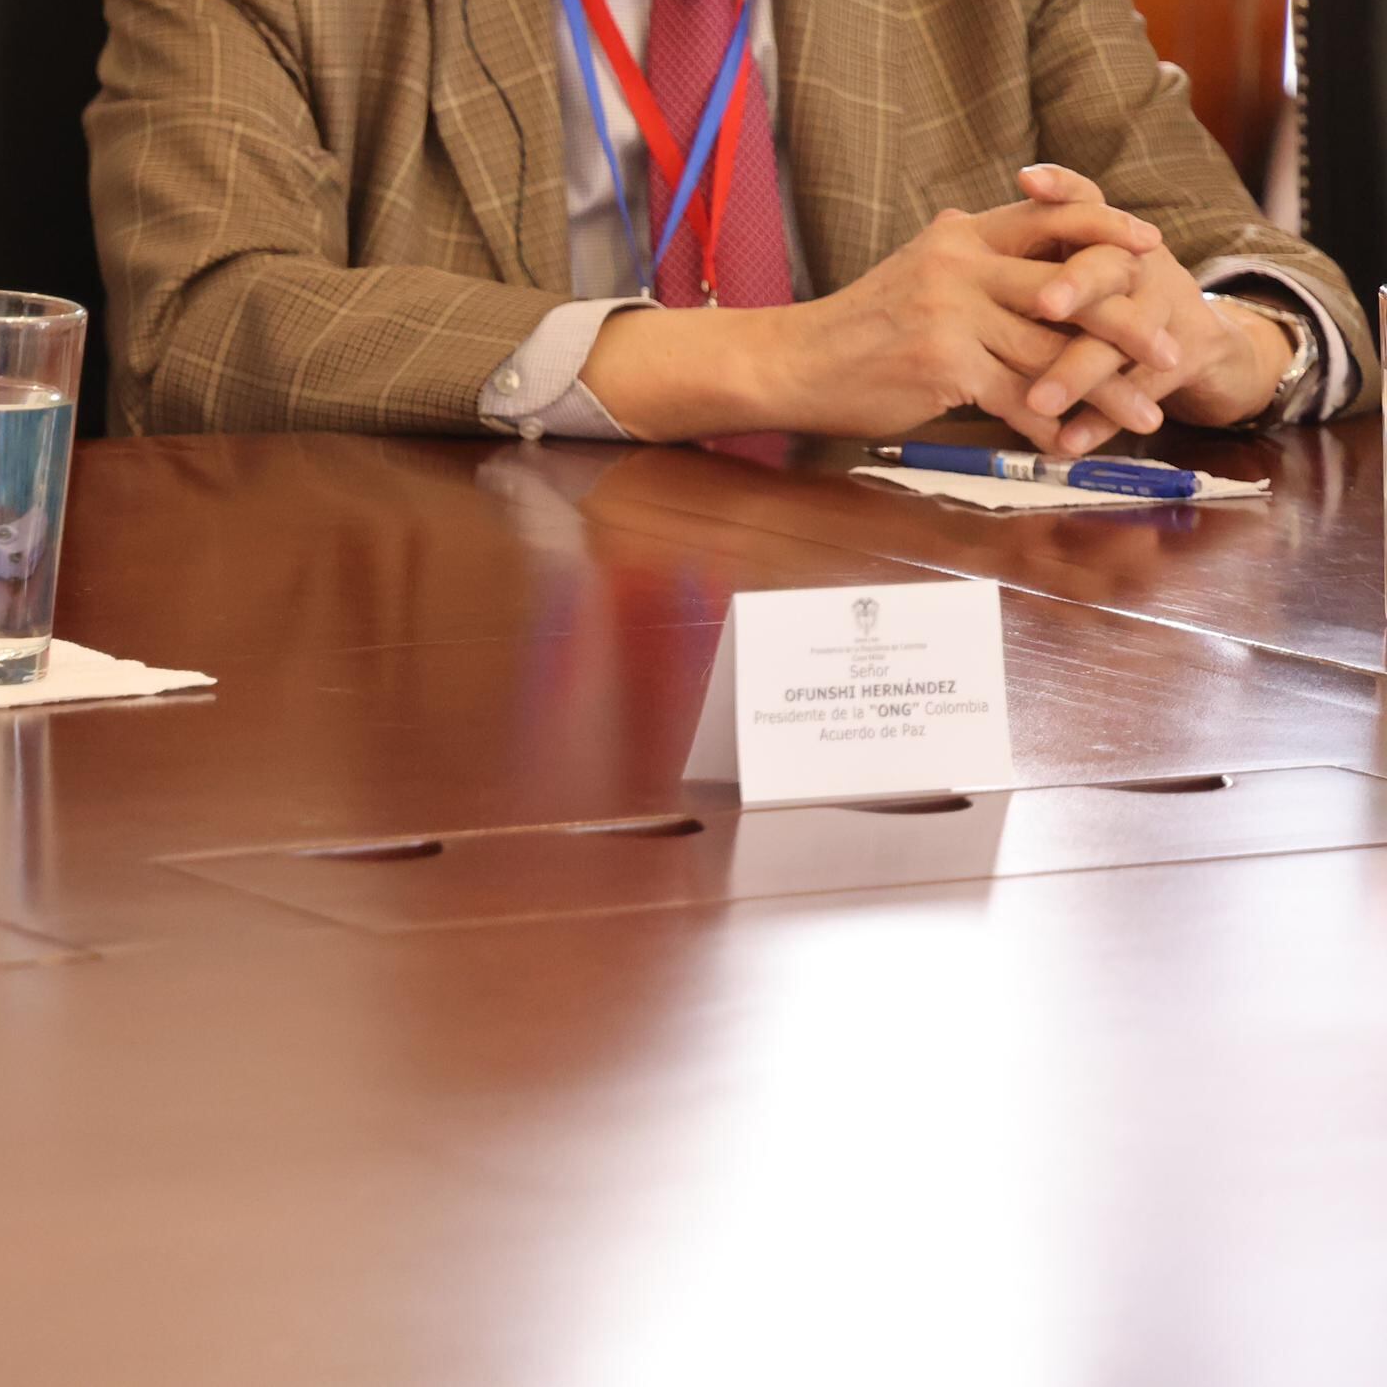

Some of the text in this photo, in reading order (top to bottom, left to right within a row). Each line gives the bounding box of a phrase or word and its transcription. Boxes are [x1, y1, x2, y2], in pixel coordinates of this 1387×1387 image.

[850, 663, 889, 679] Señor
[784, 677, 957, 703] OFUNSHI HERNÁNDEZ
[755, 709, 826, 724] Presidente
[831, 707, 847, 720] de
[853, 707, 864, 719] la
[925, 700, 989, 715] Colombia
[820, 723, 925, 741] Acuerdo de Paz
